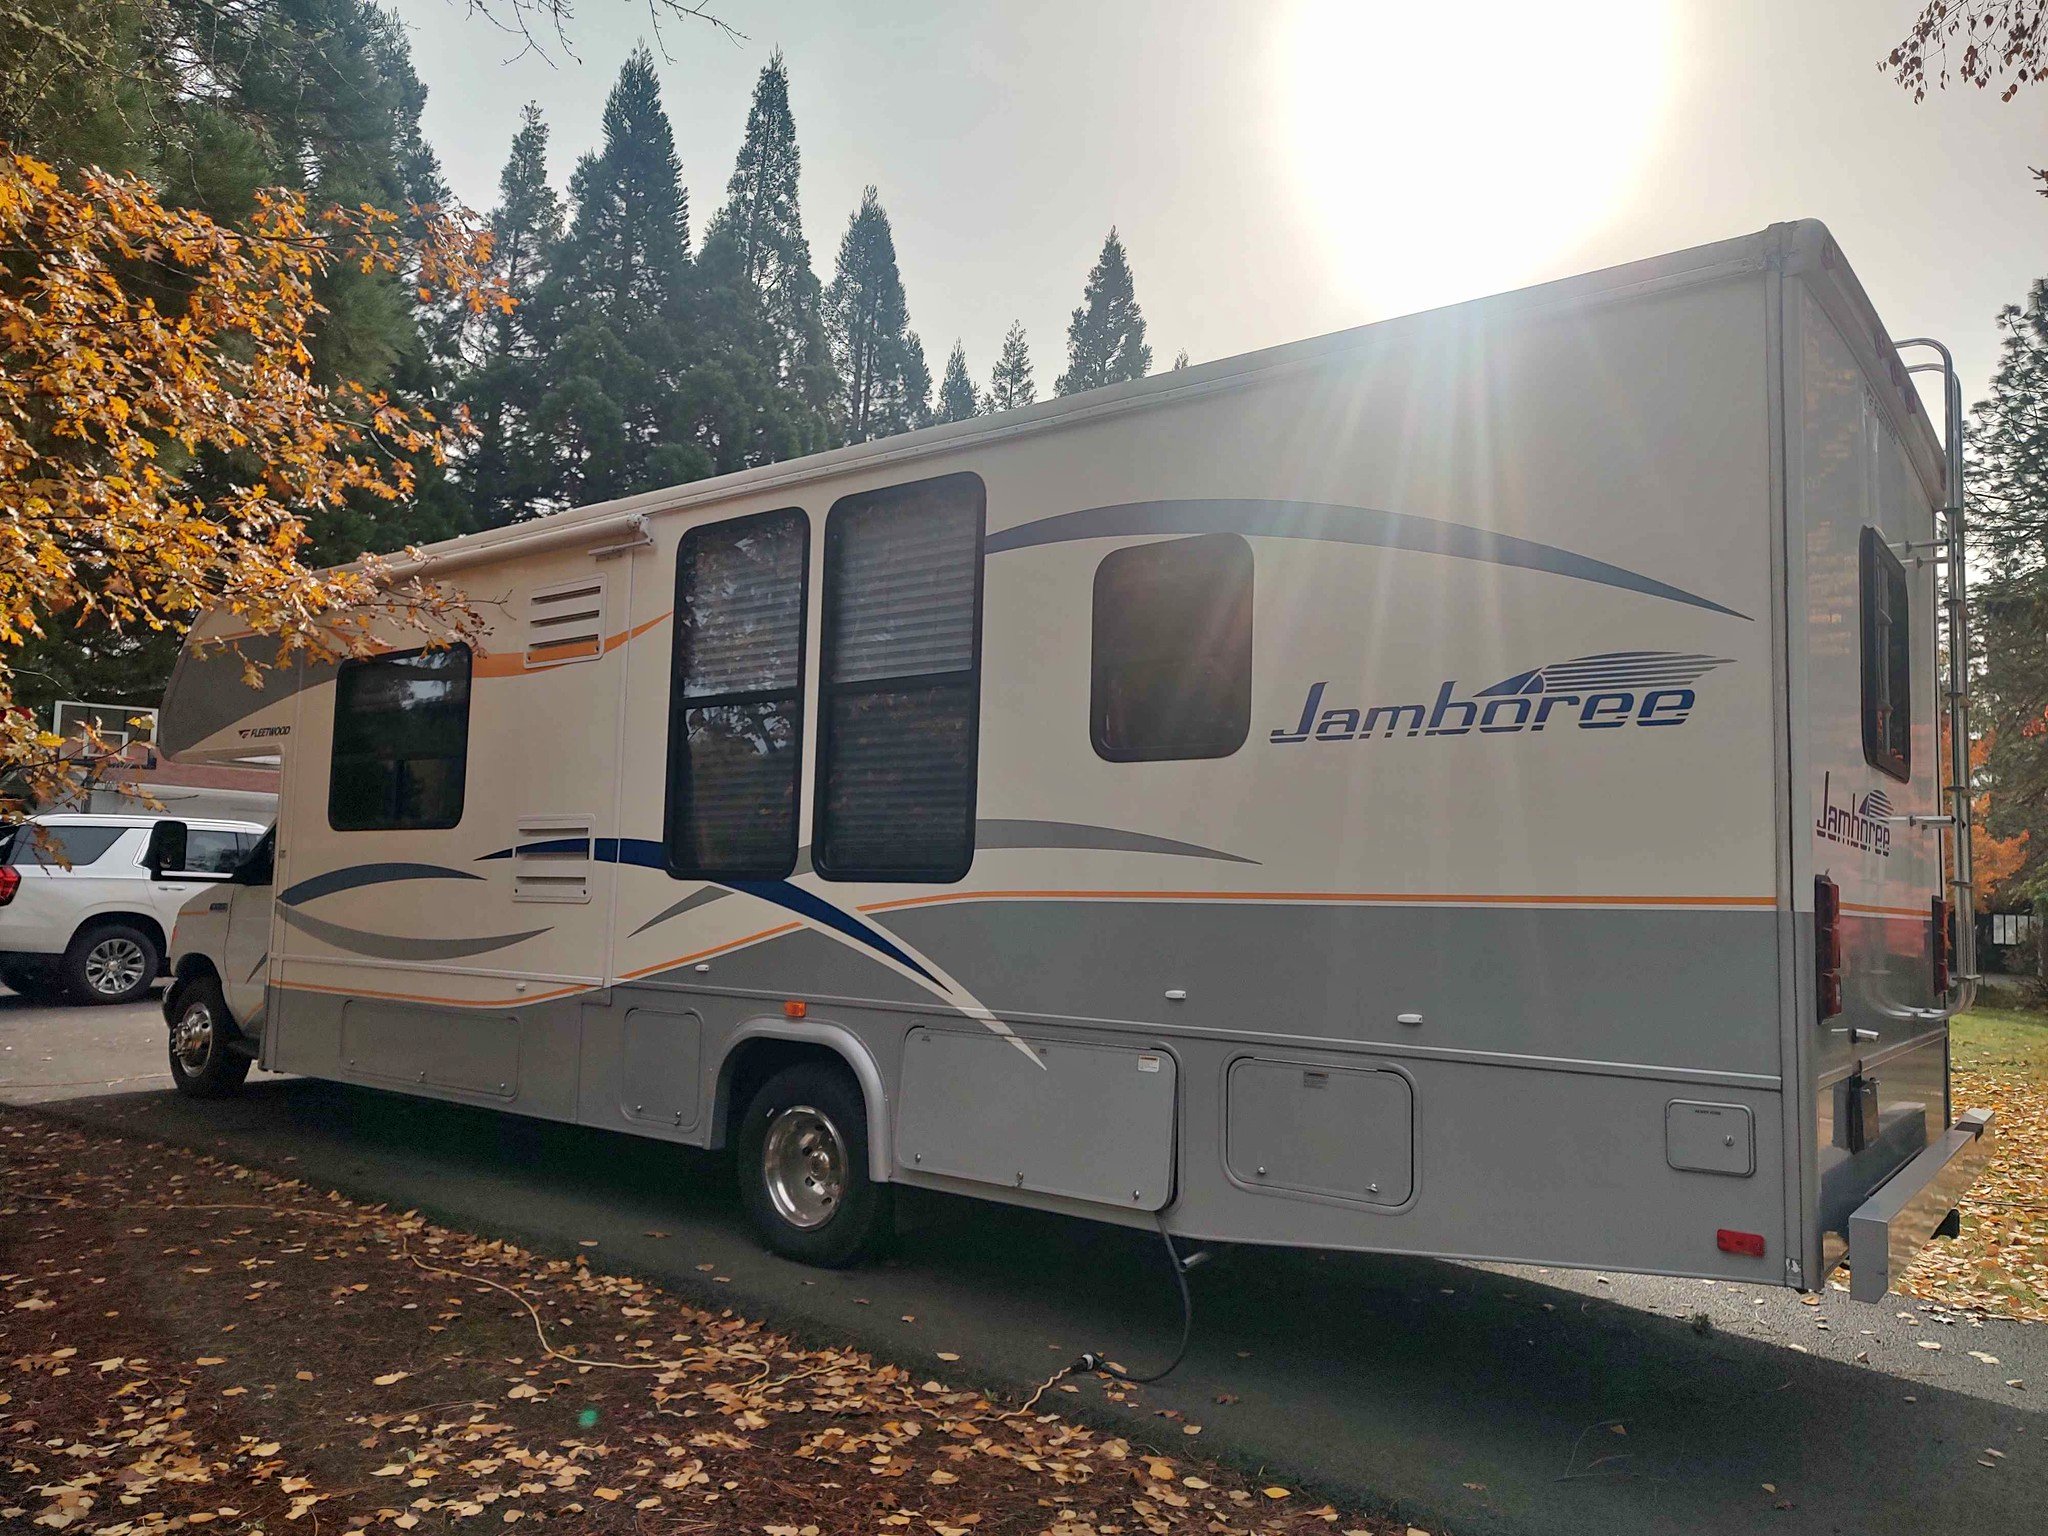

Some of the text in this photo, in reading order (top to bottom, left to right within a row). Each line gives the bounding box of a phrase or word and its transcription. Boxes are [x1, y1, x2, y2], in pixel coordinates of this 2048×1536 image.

[250, 726, 291, 738] FLEETWOOD
[1270, 681, 1696, 744] Jamboree
[1816, 771, 1891, 857] Jamboree
